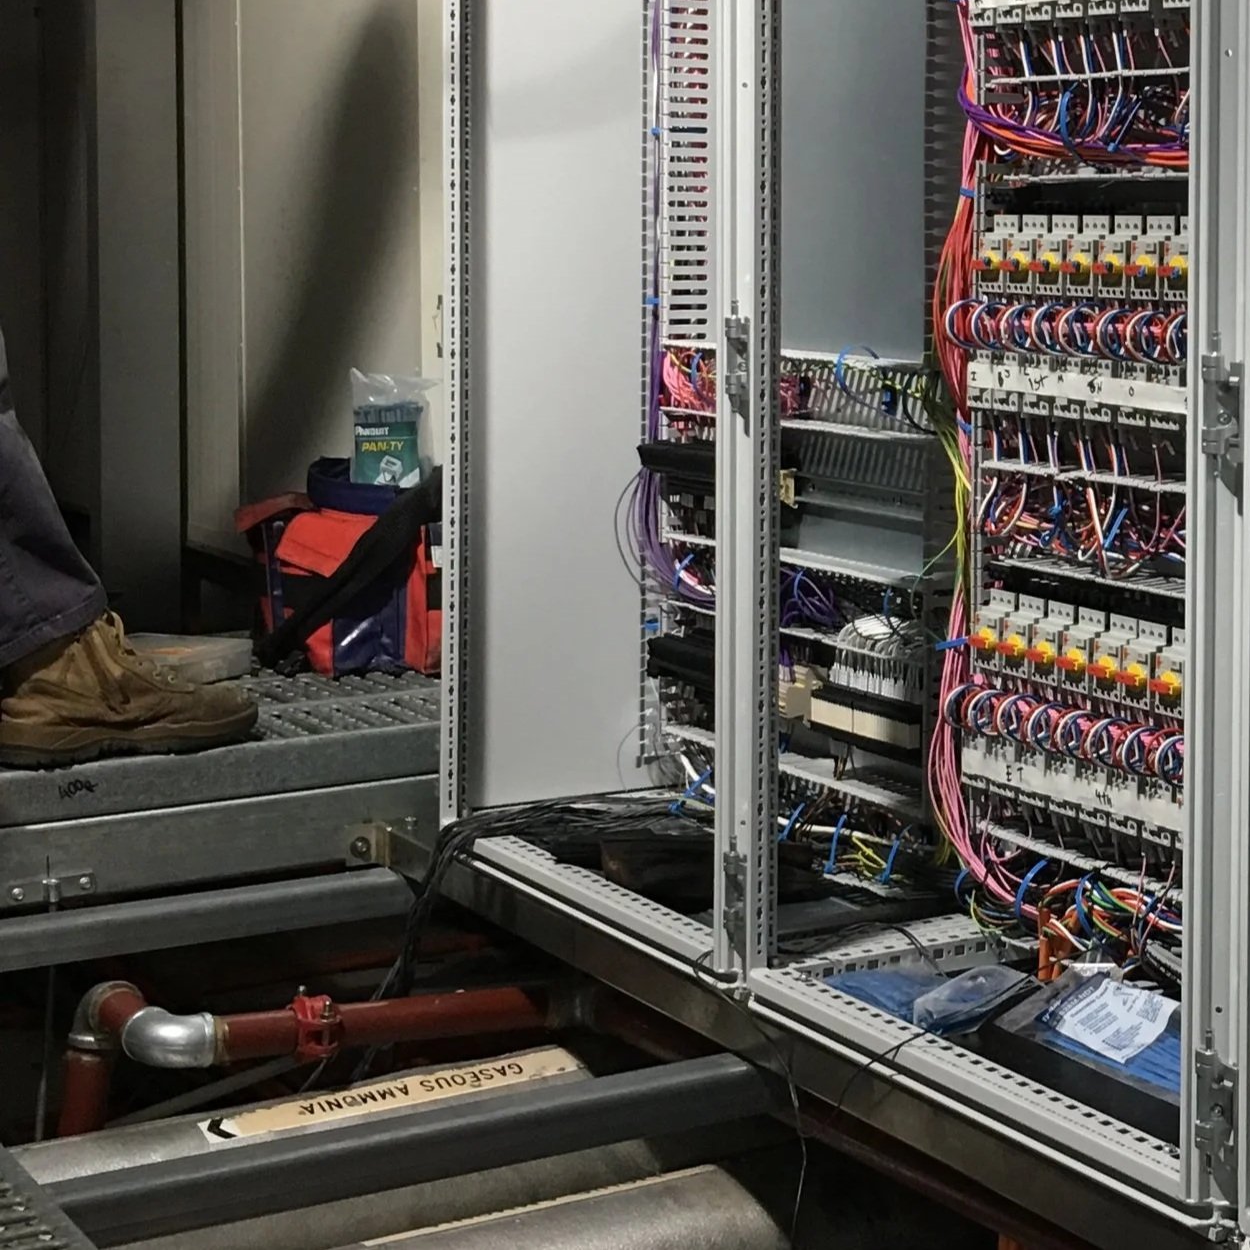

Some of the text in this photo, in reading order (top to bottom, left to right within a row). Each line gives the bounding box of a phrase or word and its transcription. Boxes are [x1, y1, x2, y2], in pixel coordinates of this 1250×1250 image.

[361, 440, 404, 452] PAN-TY
[300, 1062, 524, 1116] GASEOUS AMMONIA
